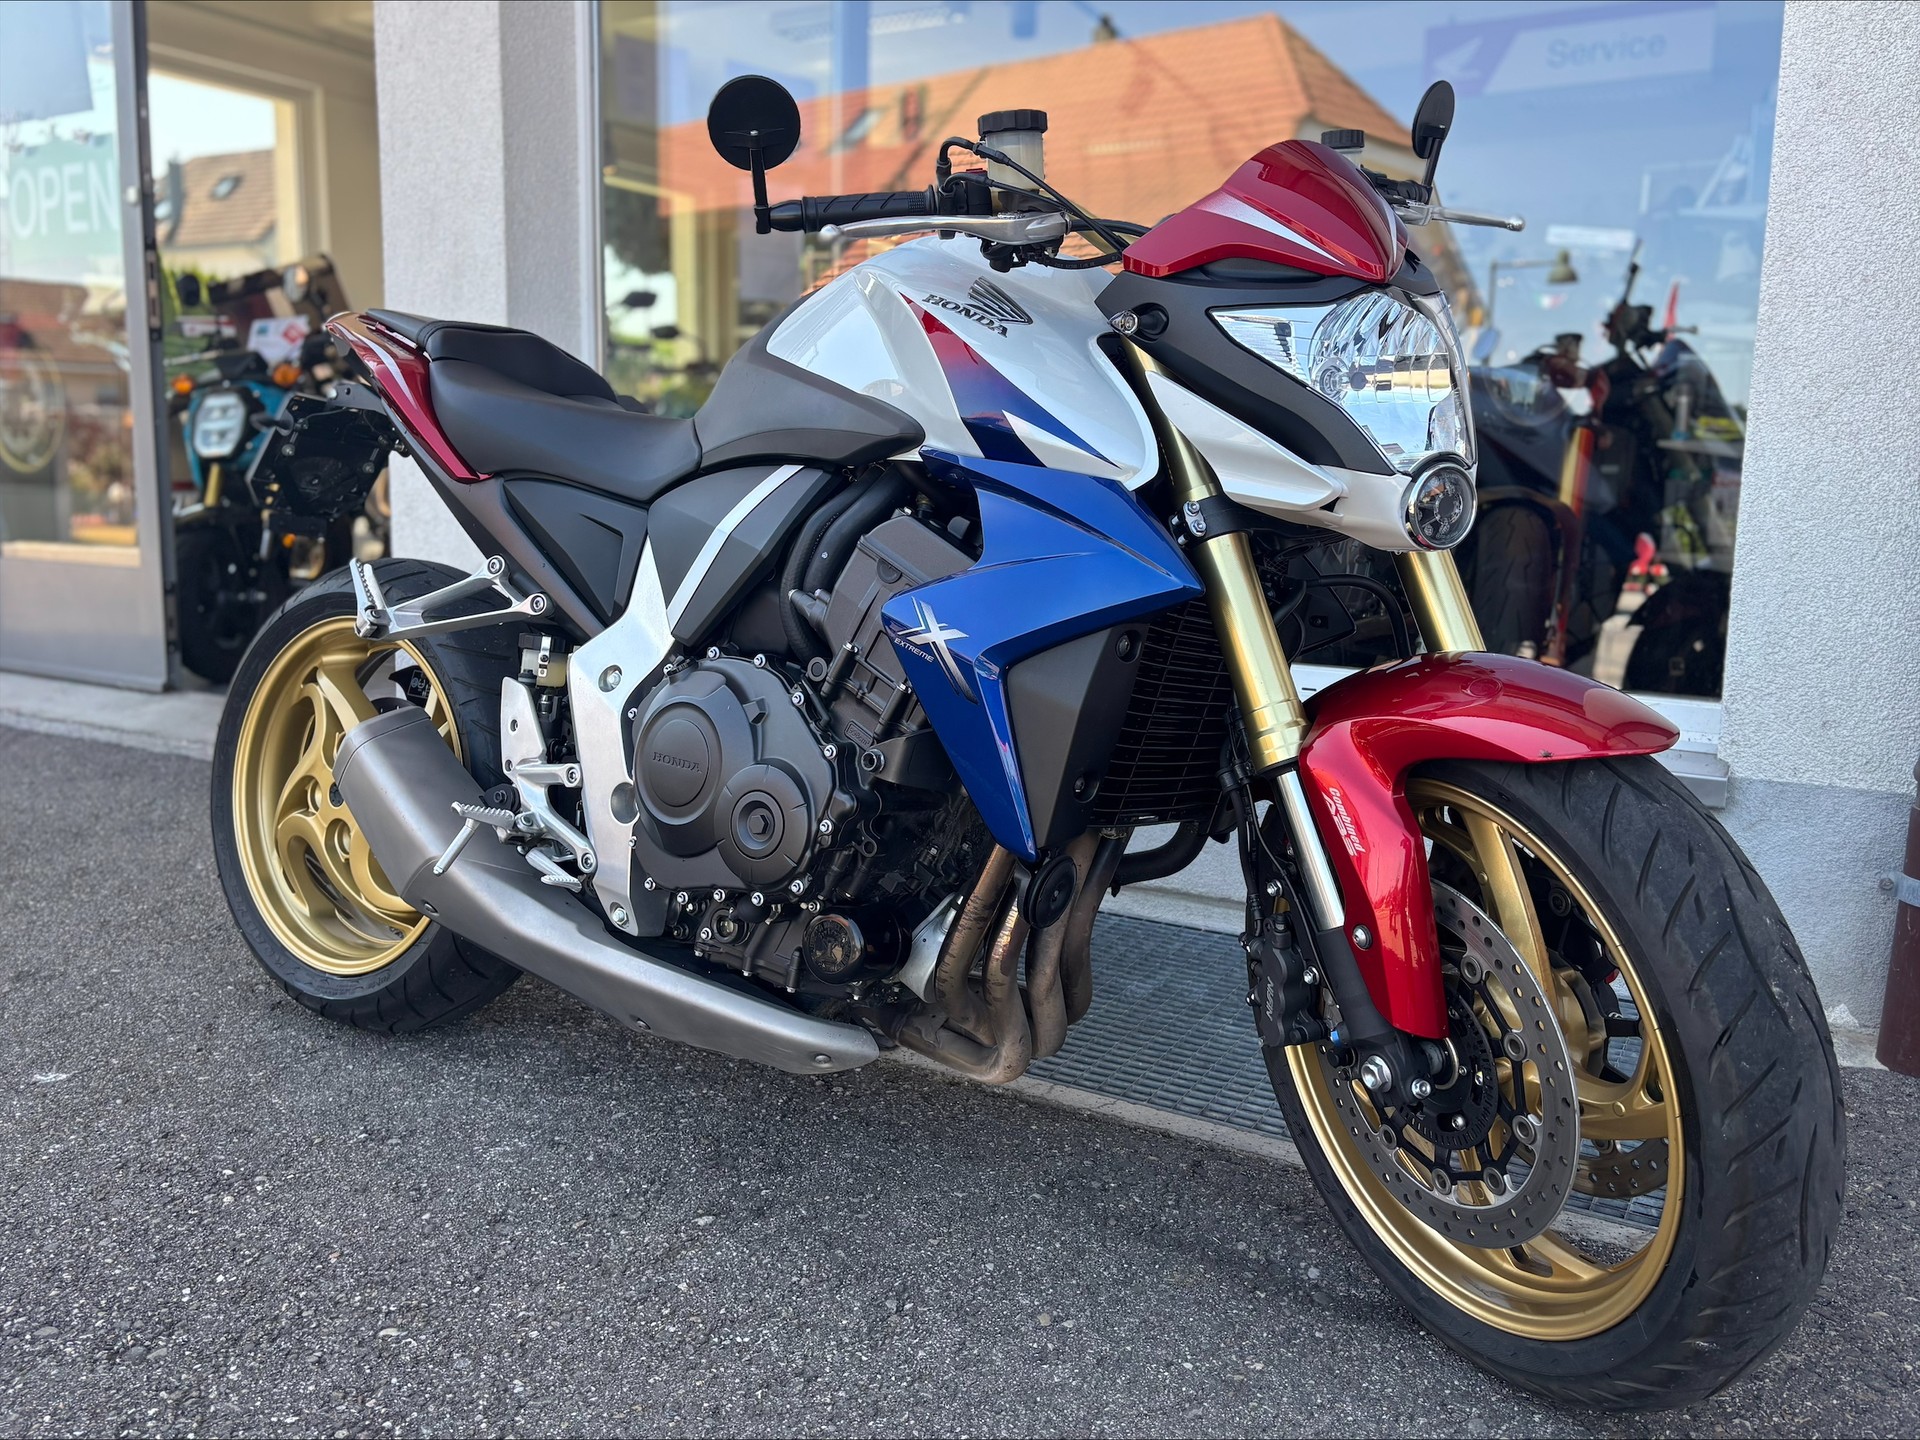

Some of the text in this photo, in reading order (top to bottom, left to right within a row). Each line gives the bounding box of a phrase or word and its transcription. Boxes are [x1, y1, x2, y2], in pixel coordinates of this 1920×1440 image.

[1547, 32, 1667, 69] Service
[9, 161, 119, 238] OPEN
[922, 294, 1008, 338] HONDA
[894, 638, 935, 663] EXTREME
[652, 751, 702, 773] HONDA
[1321, 791, 1357, 856] ABS
[1329, 787, 1366, 853] Combined
